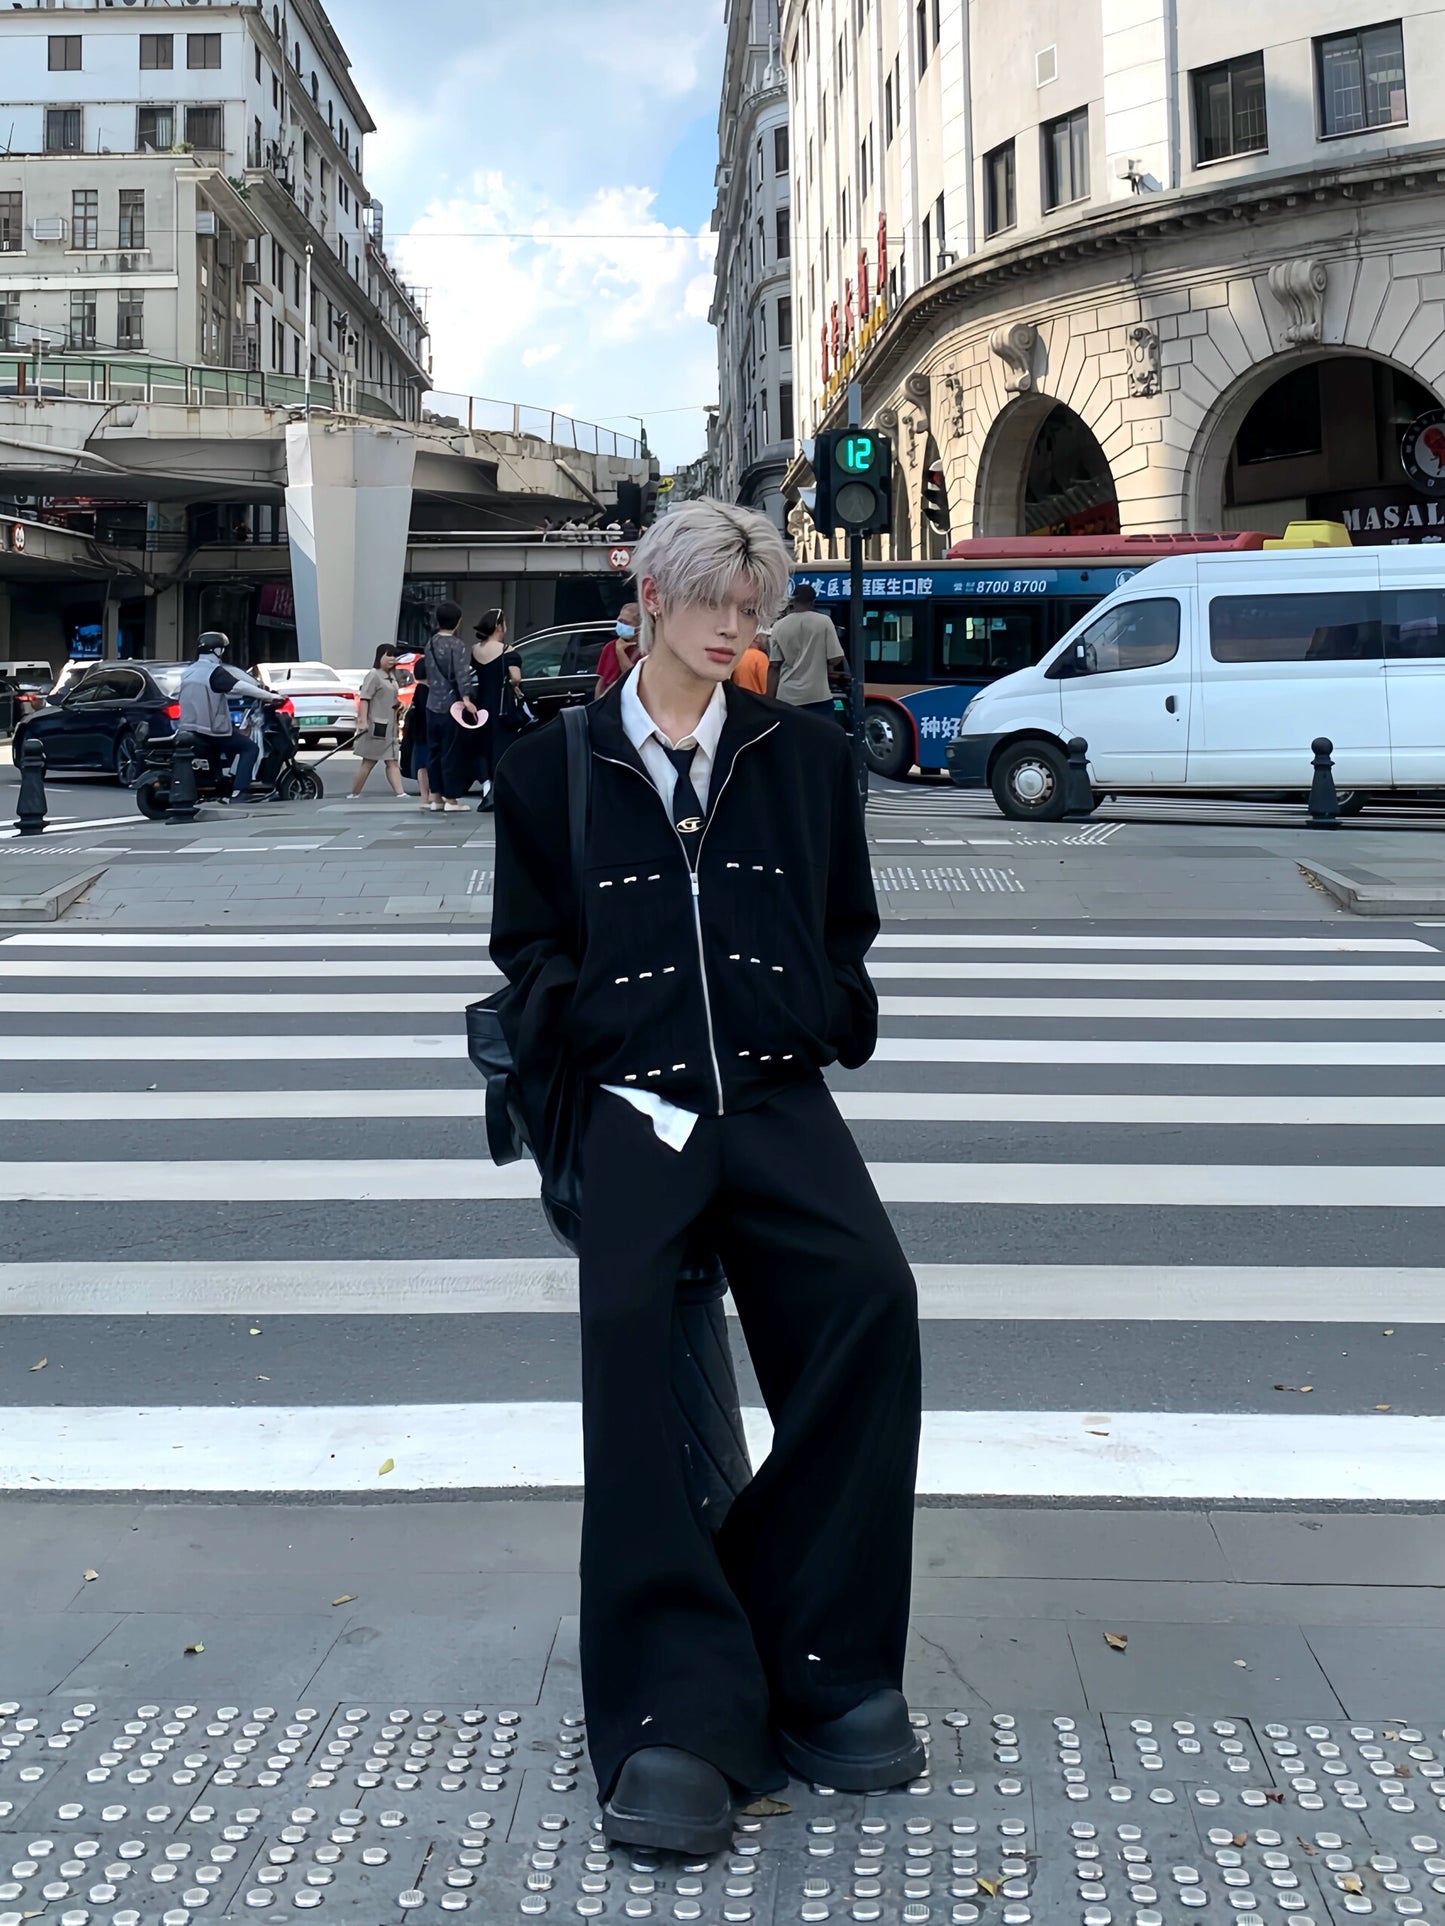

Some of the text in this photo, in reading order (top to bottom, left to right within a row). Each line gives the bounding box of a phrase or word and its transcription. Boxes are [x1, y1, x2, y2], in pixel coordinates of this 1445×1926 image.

[847, 438, 871, 469] 12
[976, 580, 1009, 594] 8700
[1013, 580, 1047, 593] 8700
